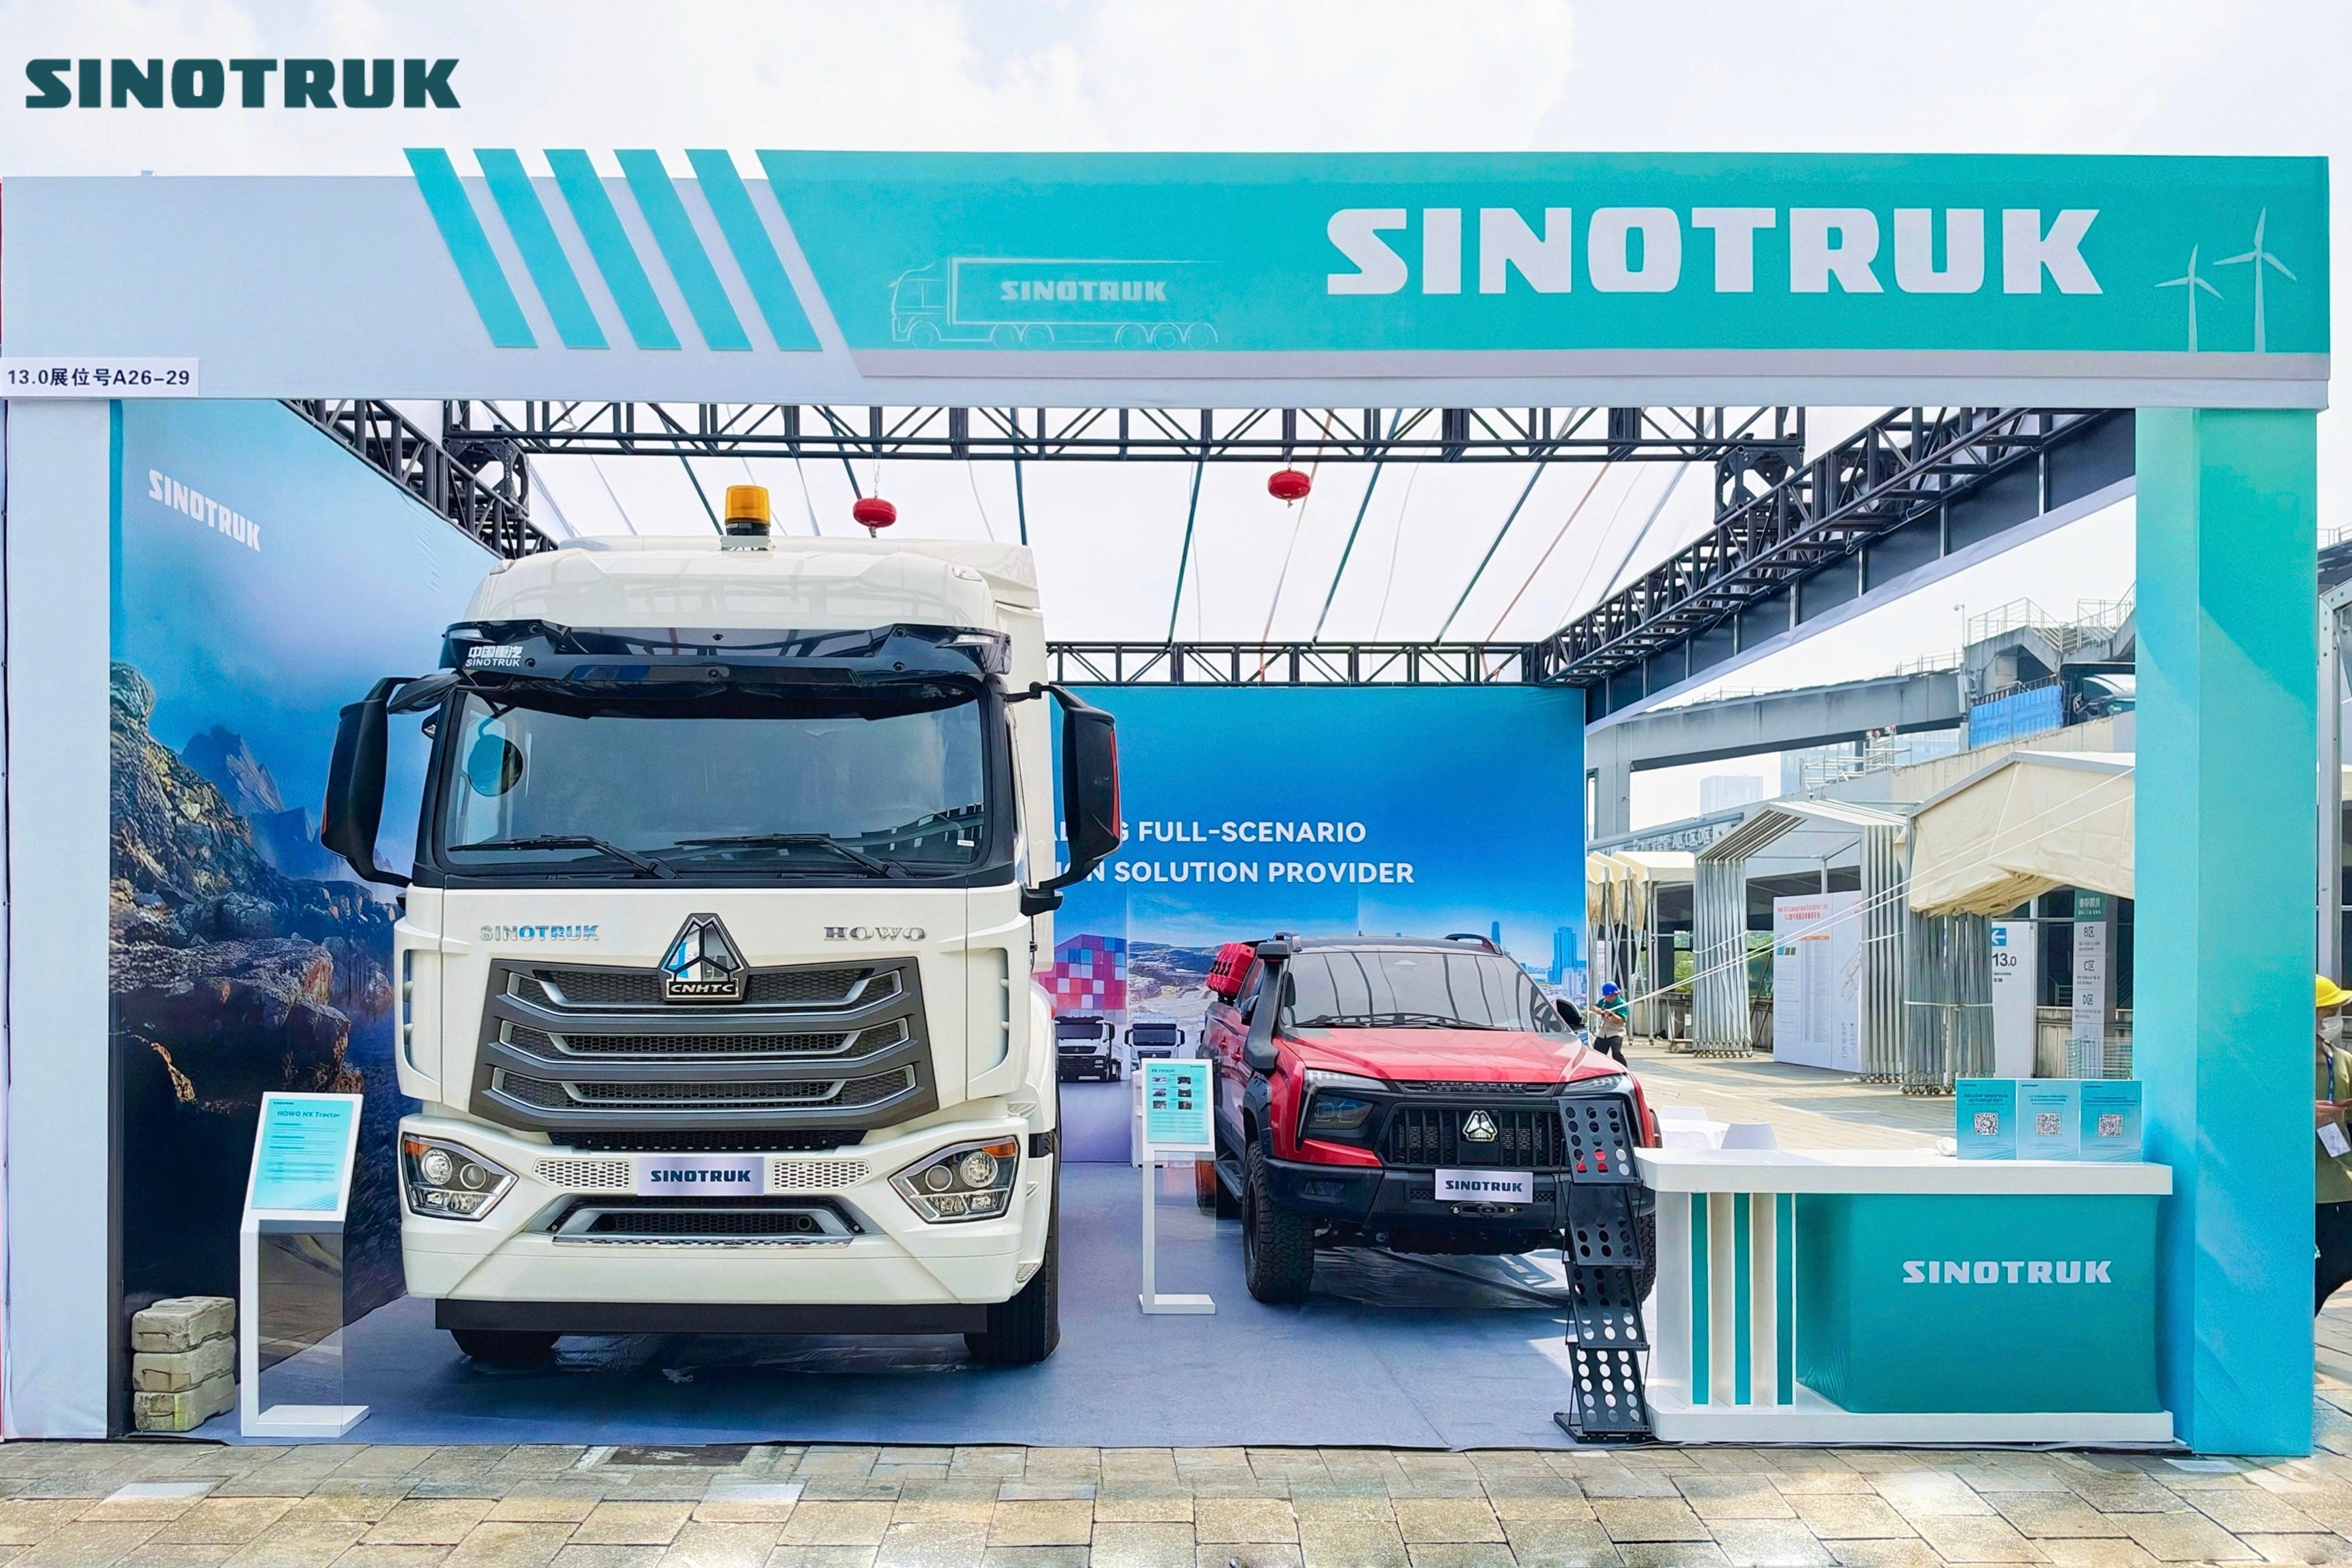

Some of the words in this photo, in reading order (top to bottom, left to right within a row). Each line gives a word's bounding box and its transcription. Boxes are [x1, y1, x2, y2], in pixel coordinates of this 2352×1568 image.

[1327, 207, 2103, 294] SINOTRUK
[1000, 281, 1167, 302] SINOTRUK
[8, 368, 190, 387] 13.0展位号A26-29
[149, 469, 261, 552] SINOTRUK
[468, 645, 523, 659] 中国重汽
[466, 658, 520, 667] SINOTRUK
[1138, 821, 1367, 843] FULL-SCENARIO
[1114, 860, 1258, 883] SOLUTION
[1268, 862, 1415, 883] PROVIDER
[480, 925, 600, 942] SINOTRUK
[823, 926, 927, 942] HOWO
[1992, 953, 2017, 967] 13.0
[671, 984, 734, 993] CNHTC
[651, 1170, 751, 1182] SINOTRUK
[1445, 1180, 1523, 1192] SINOTRUK
[1903, 1261, 2112, 1283] SINOTRUK
